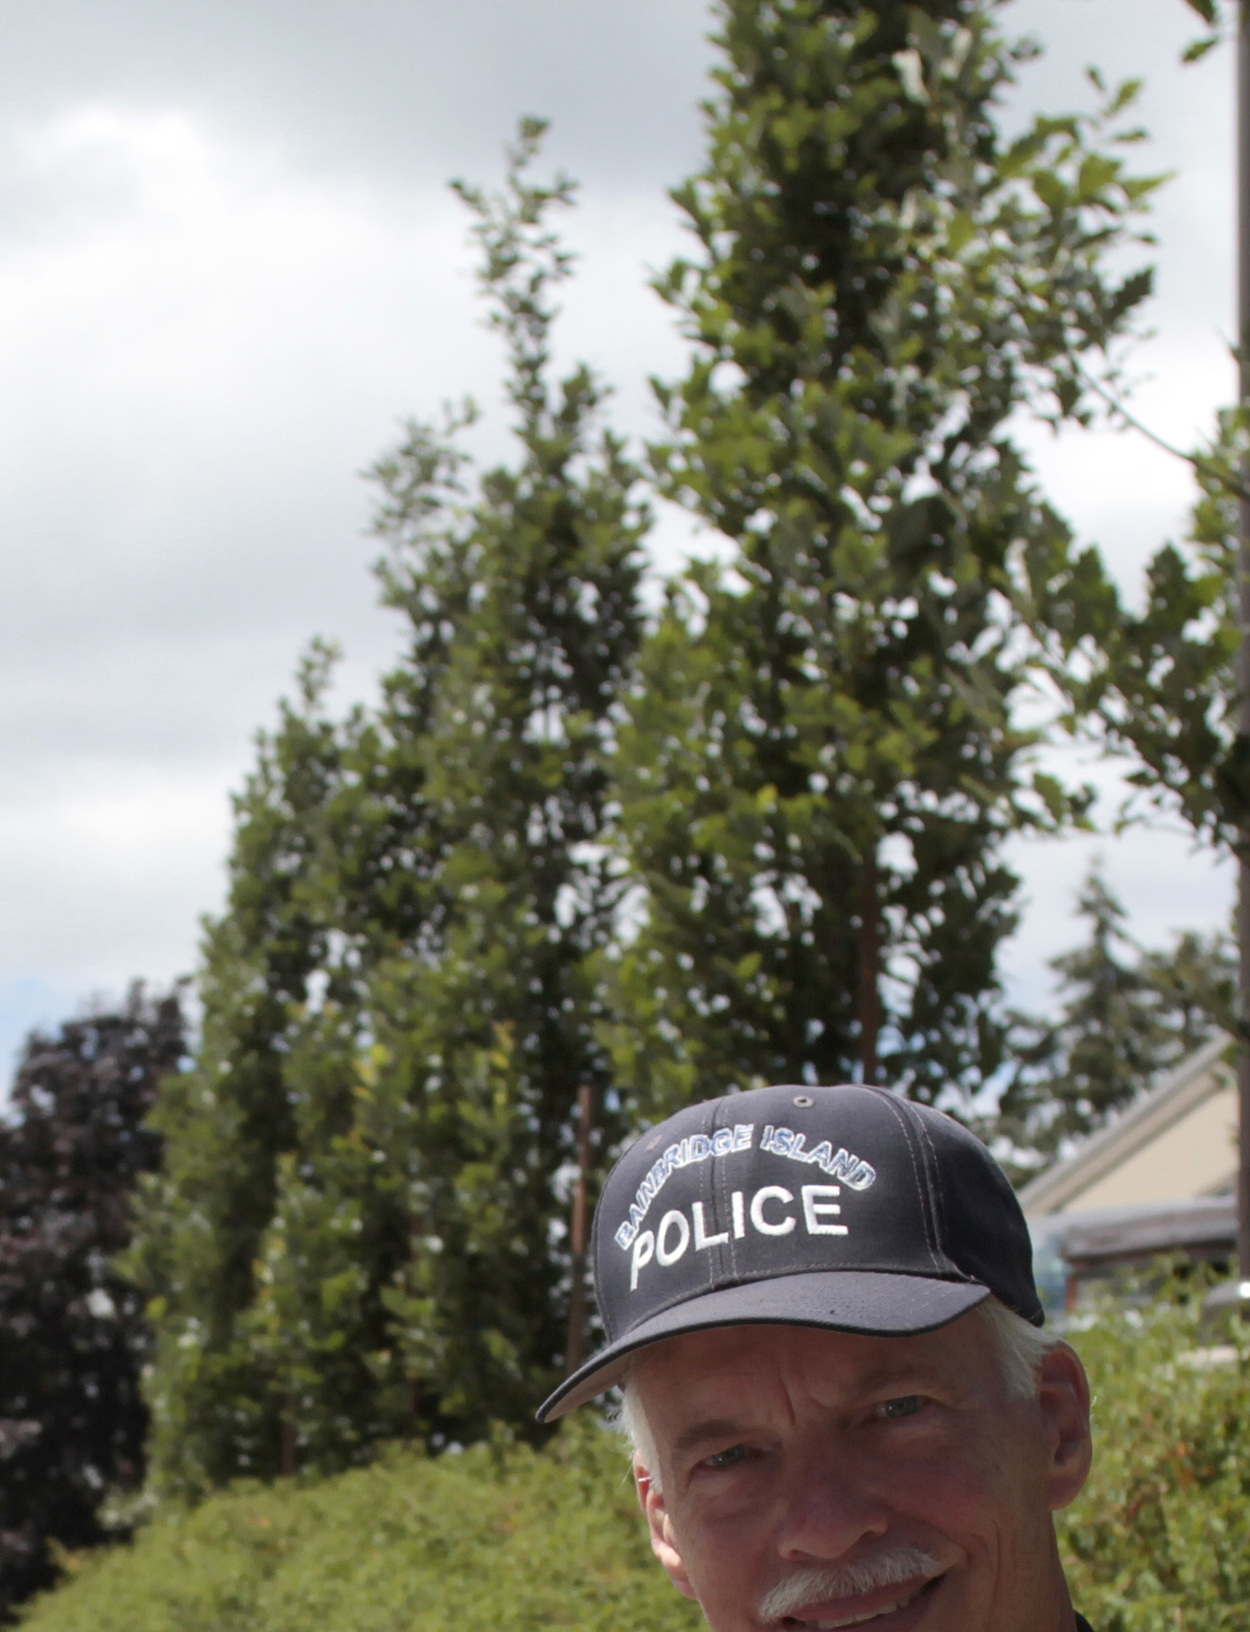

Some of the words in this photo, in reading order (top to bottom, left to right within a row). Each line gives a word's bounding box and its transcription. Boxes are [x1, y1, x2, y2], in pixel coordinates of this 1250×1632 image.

[614, 1123, 755, 1251] BAINBRIDGE
[760, 1124, 877, 1191] ISLAND
[630, 1184, 849, 1292] POLICE
